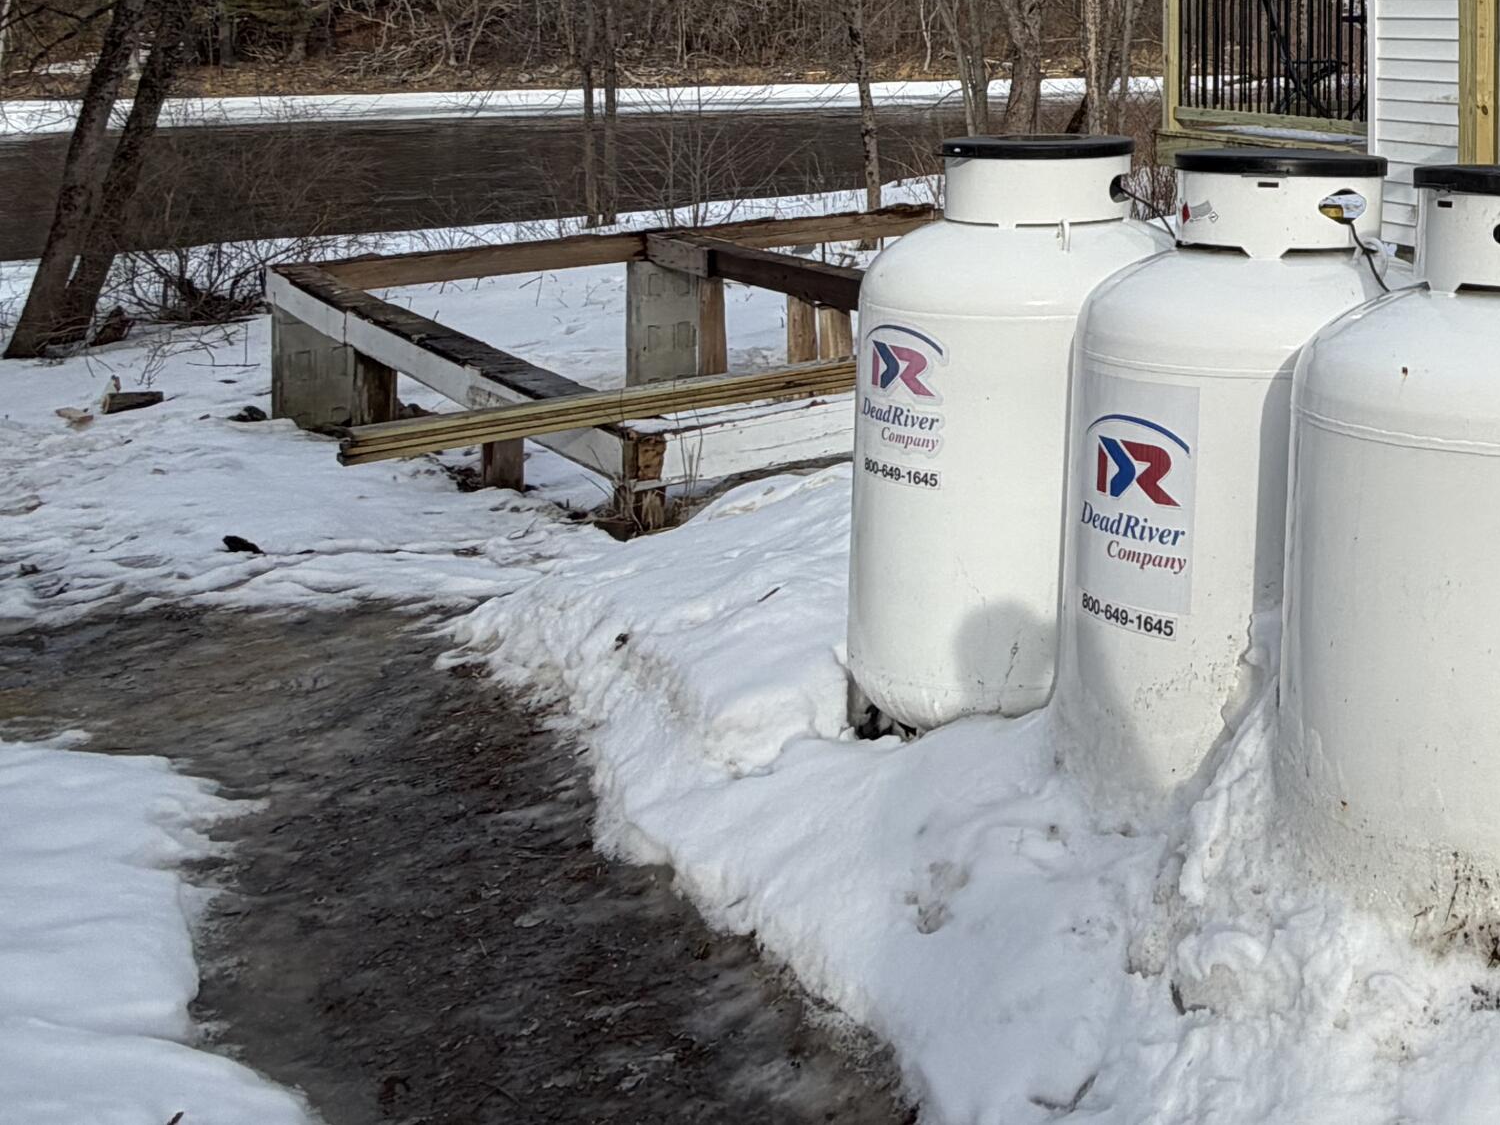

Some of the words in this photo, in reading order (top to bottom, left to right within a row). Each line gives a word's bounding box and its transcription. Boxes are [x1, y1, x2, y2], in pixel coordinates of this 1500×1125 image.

[881, 426, 939, 452] Company
[864, 457, 939, 488] 800-649-1645
[1106, 540, 1187, 574] Company
[1081, 592, 1175, 638] 800-649-1645
